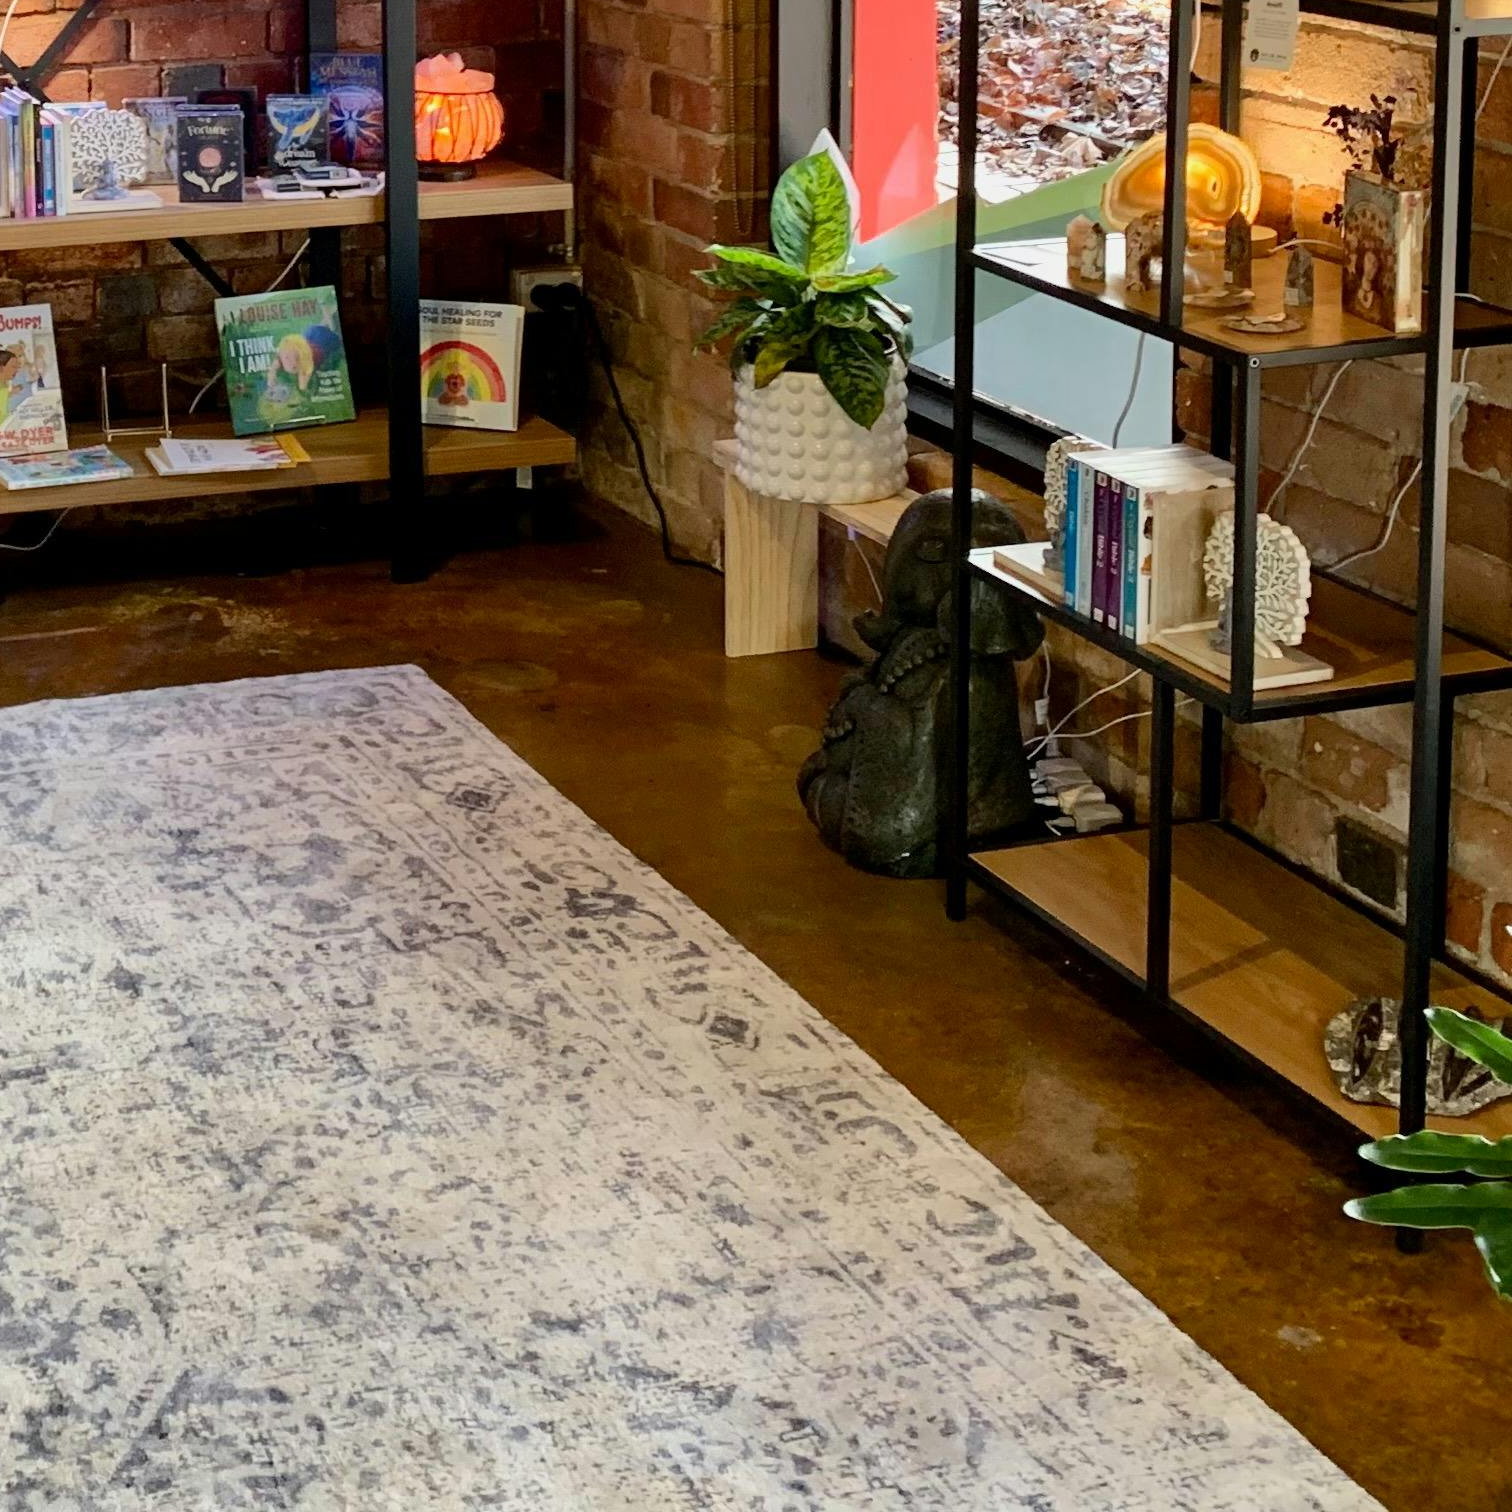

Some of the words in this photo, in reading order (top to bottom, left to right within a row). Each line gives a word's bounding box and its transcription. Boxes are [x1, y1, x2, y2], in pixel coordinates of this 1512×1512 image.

[239, 302, 288, 325] LOUISE
[291, 298, 319, 317] HAY
[442, 308, 481, 318] HEALING
[483, 310, 503, 319] FOR
[423, 316, 440, 325] THE
[441, 317, 464, 326] STAR
[465, 319, 496, 328] SEEDS
[229, 340, 236, 358] I
[238, 356, 246, 374] I
